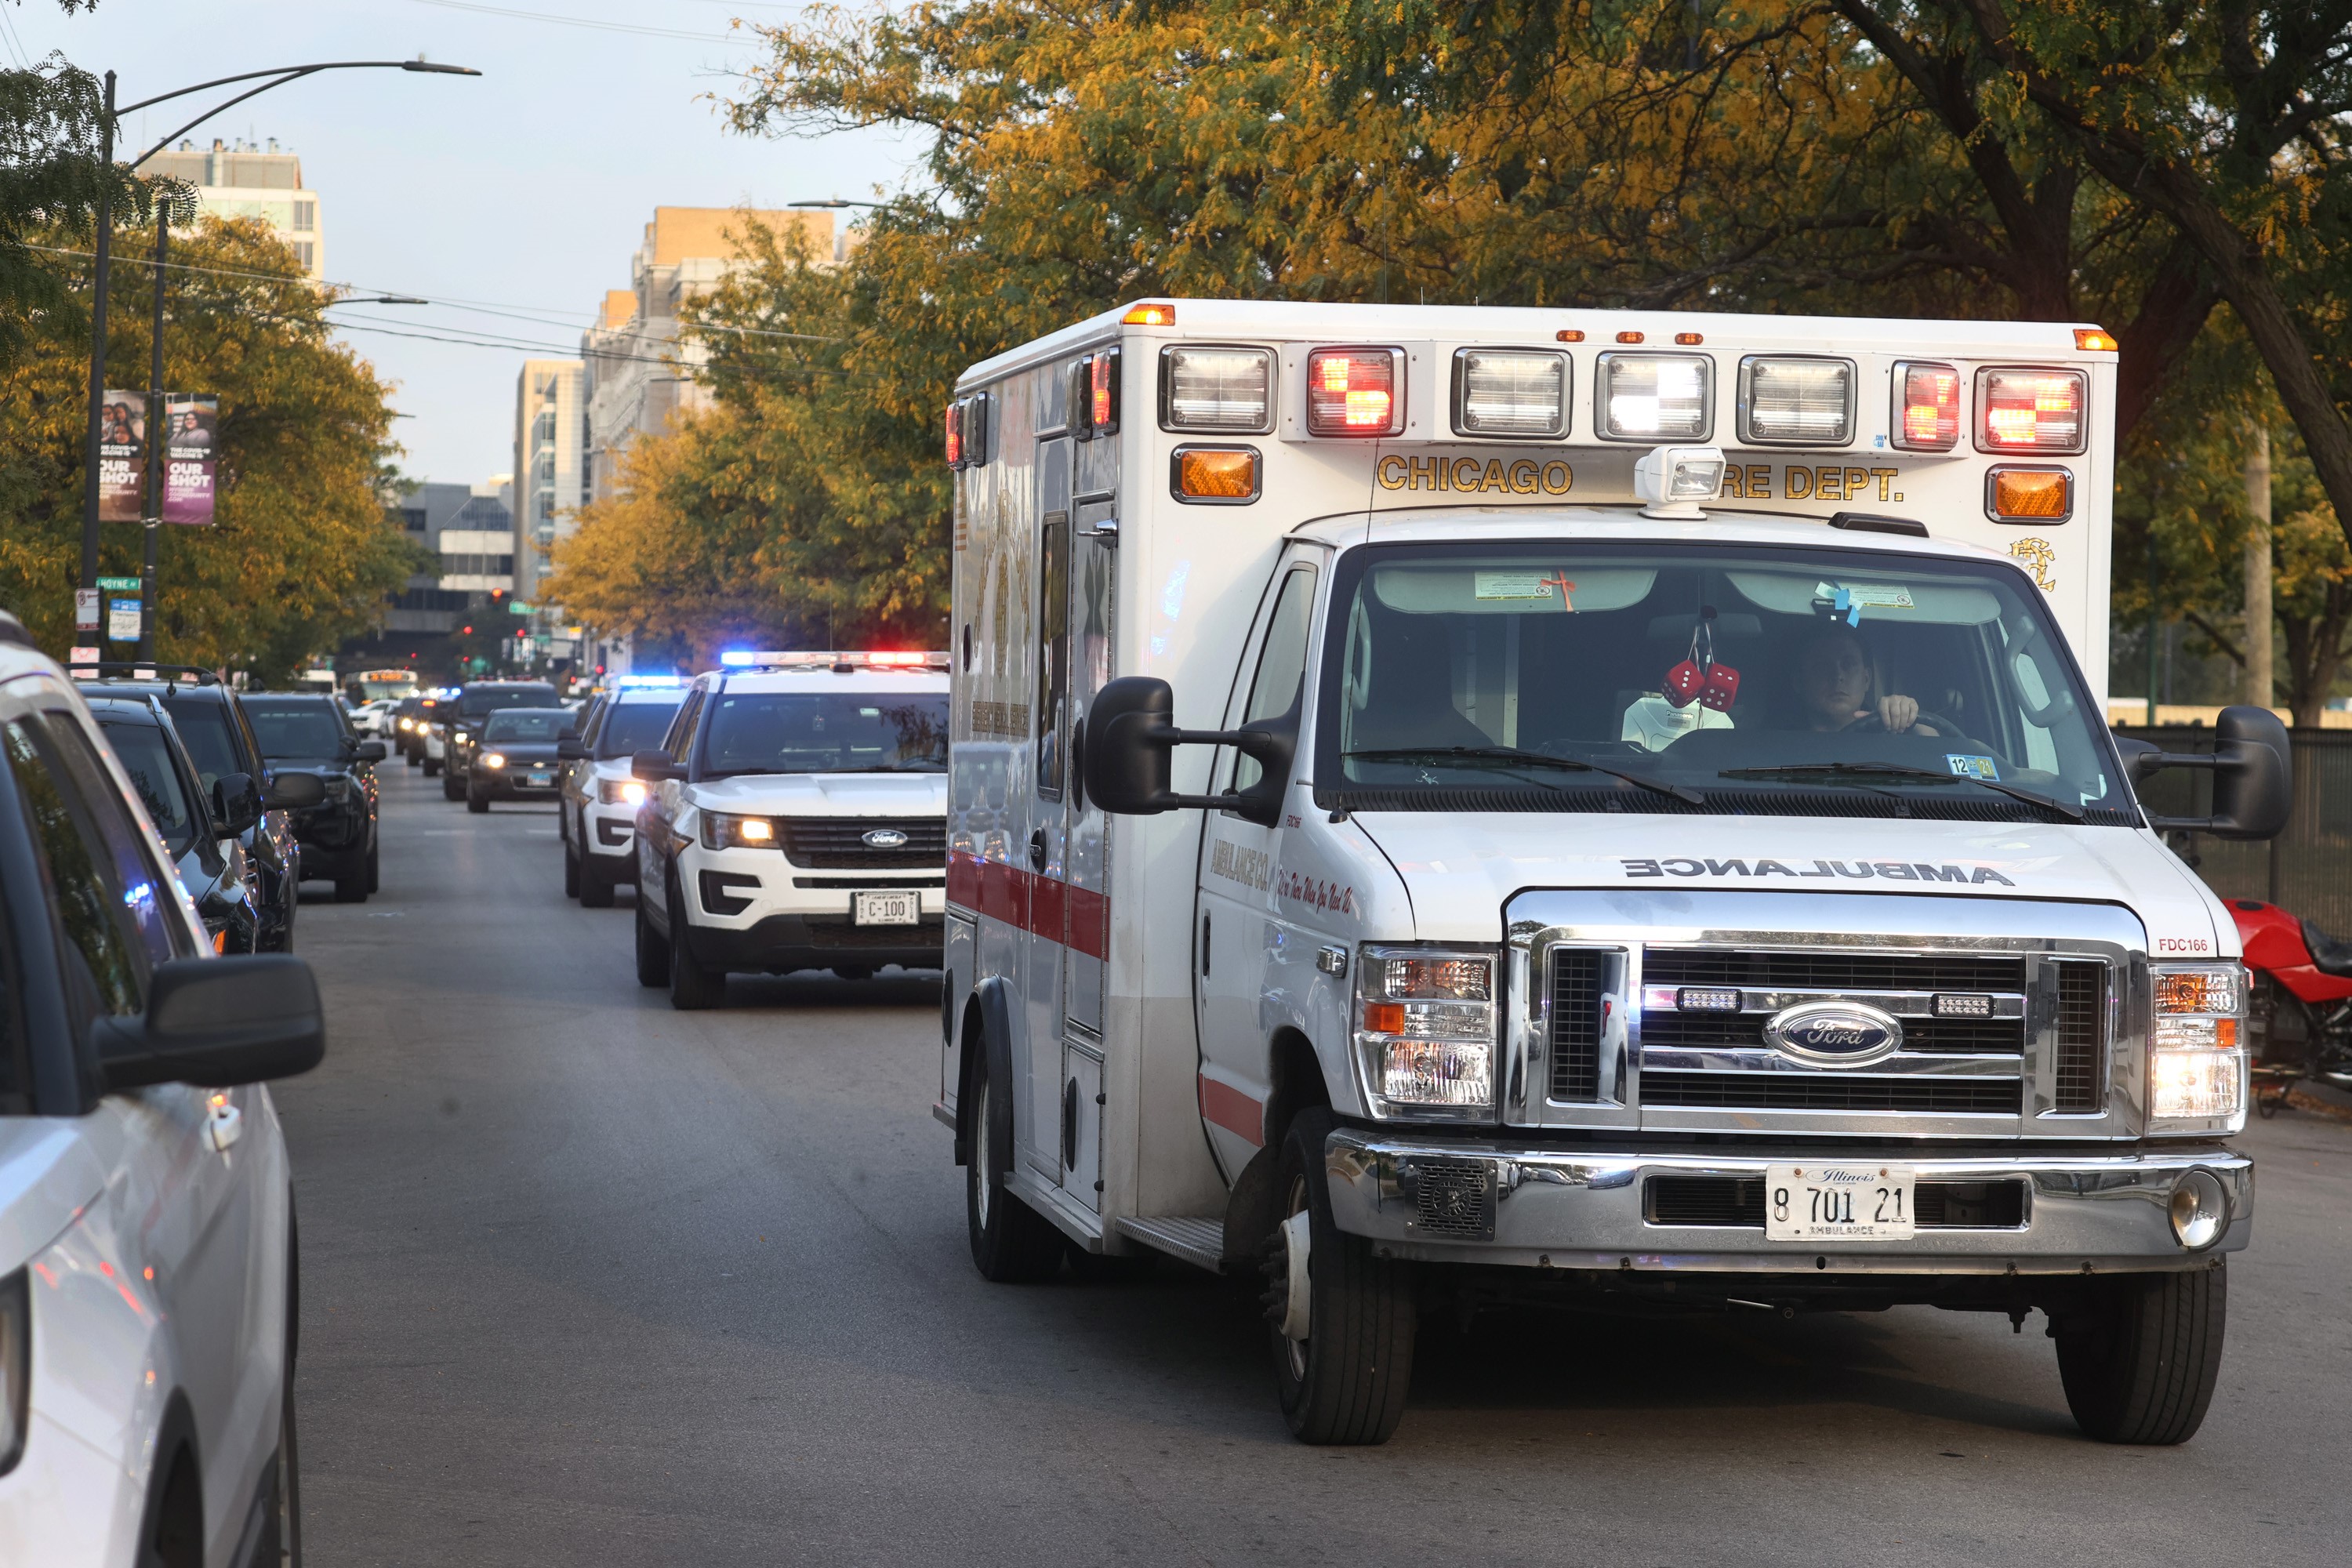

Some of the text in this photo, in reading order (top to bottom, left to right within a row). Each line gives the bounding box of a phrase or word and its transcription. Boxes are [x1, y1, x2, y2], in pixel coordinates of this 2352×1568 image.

[100, 459, 130, 473] OUR
[169, 462, 204, 475] OUR
[100, 471, 139, 485] SHOT
[168, 474, 212, 488] SHOT
[1377, 455, 1573, 495] CHICAGO
[1720, 465, 1904, 502] RE DEPT.
[100, 579, 129, 589] HOYNE
[1666, 710, 1694, 719] Panasonic
[1952, 758, 1993, 775] 12 21
[872, 832, 898, 843] Ford
[1210, 838, 1257, 887] AMBULANCE
[1290, 872, 1302, 901] There
[1303, 876, 1317, 905] When
[1316, 880, 1328, 914] You
[1328, 882, 1344, 913] Need
[1342, 887, 1353, 914] Us
[869, 901, 905, 916] C-100
[2158, 938, 2208, 951] FDC166
[1806, 1018, 1866, 1046] Ford
[1806, 1168, 1876, 1183] Illinois
[1774, 1186, 1907, 1223] 8 701 21
[1809, 1226, 1874, 1235] AMBULANCE
